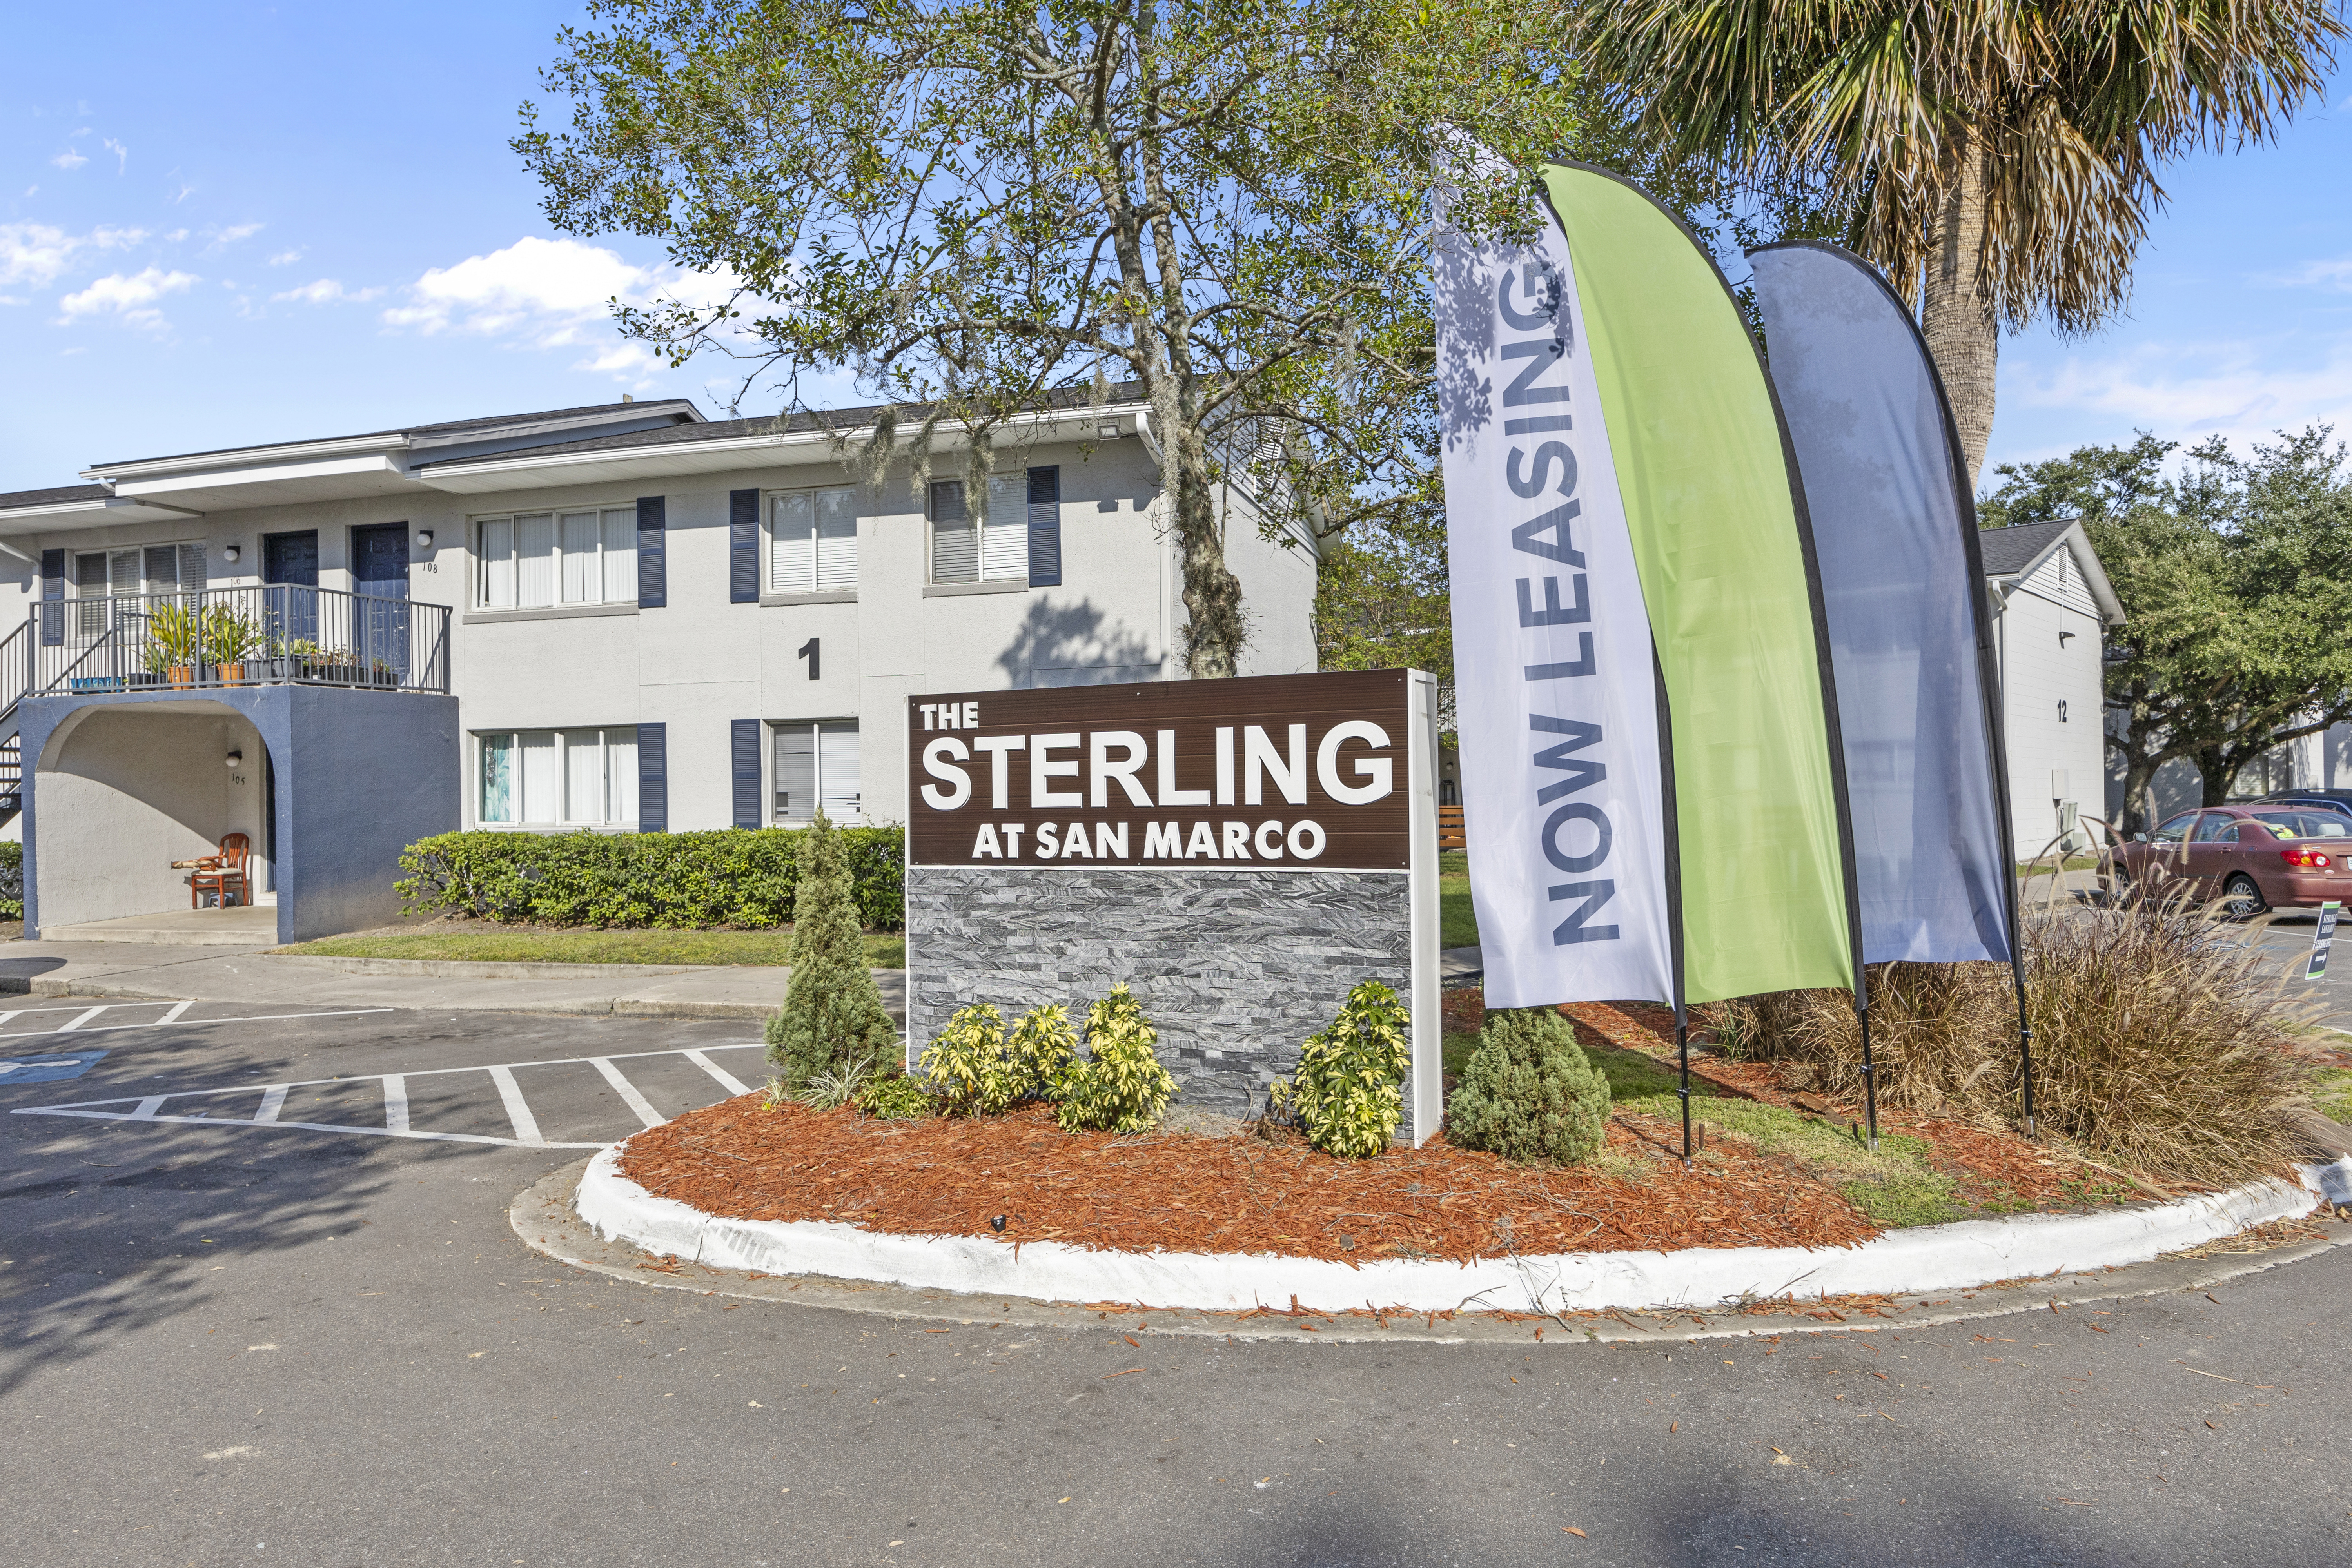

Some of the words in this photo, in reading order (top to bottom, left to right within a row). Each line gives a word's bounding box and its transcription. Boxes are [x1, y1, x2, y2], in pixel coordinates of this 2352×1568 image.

[1498, 260, 1597, 682] LEASING
[231, 575, 240, 588] 106
[423, 561, 437, 573] 108
[798, 637, 820, 681] 1
[920, 702, 979, 731] THE
[2057, 699, 2067, 723] 12
[232, 773, 245, 786] 105
[920, 720, 1393, 811] STERLING
[971, 823, 1025, 859] AT
[1035, 822, 1129, 859] SAN
[1143, 820, 1327, 860] MARCO
[1529, 713, 1620, 946] NOW
